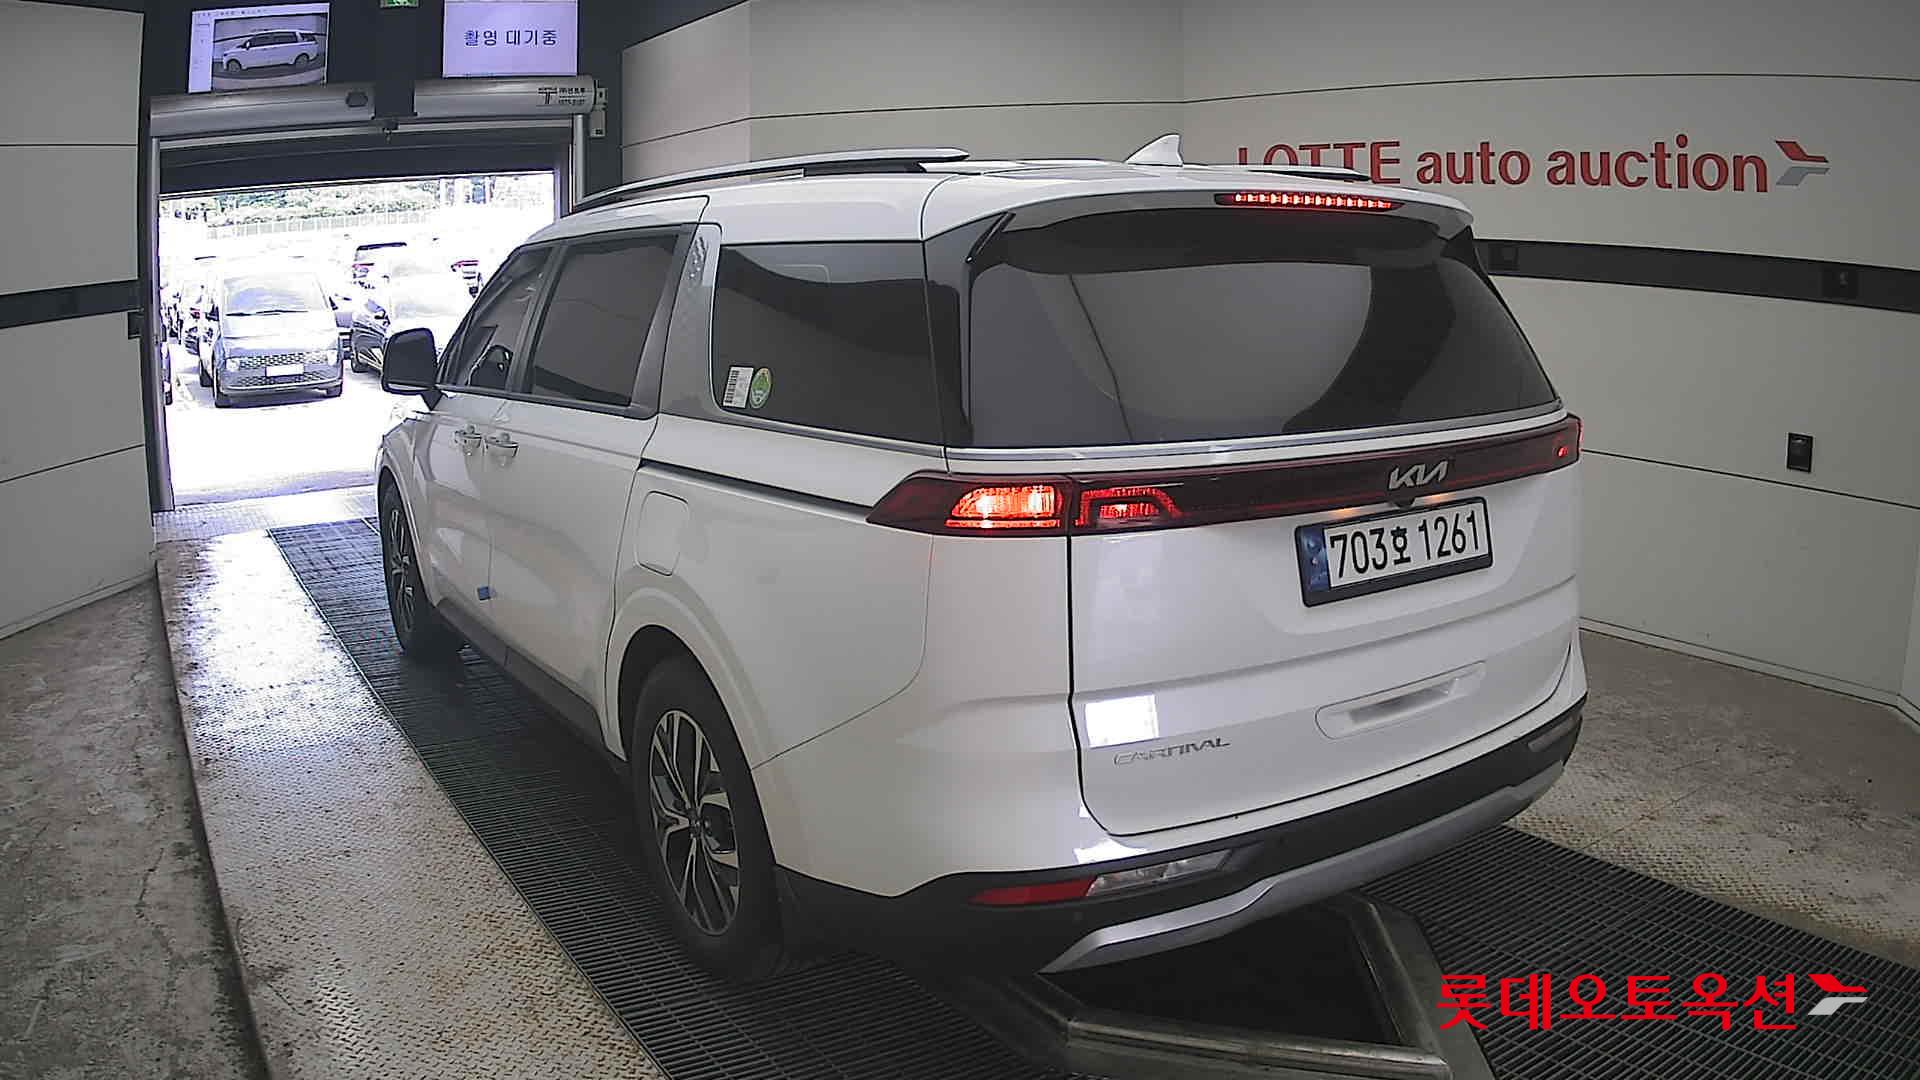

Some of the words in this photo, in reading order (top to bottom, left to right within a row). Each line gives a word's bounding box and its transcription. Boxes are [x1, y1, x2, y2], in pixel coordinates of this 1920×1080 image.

[505, 30, 557, 46] 대기중
[1416, 142, 1530, 185] auto
[1546, 134, 1768, 193] auction
[1329, 526, 1411, 579] 703호
[1418, 509, 1480, 561] 1261
[1112, 738, 1231, 766] CARNIVAL
